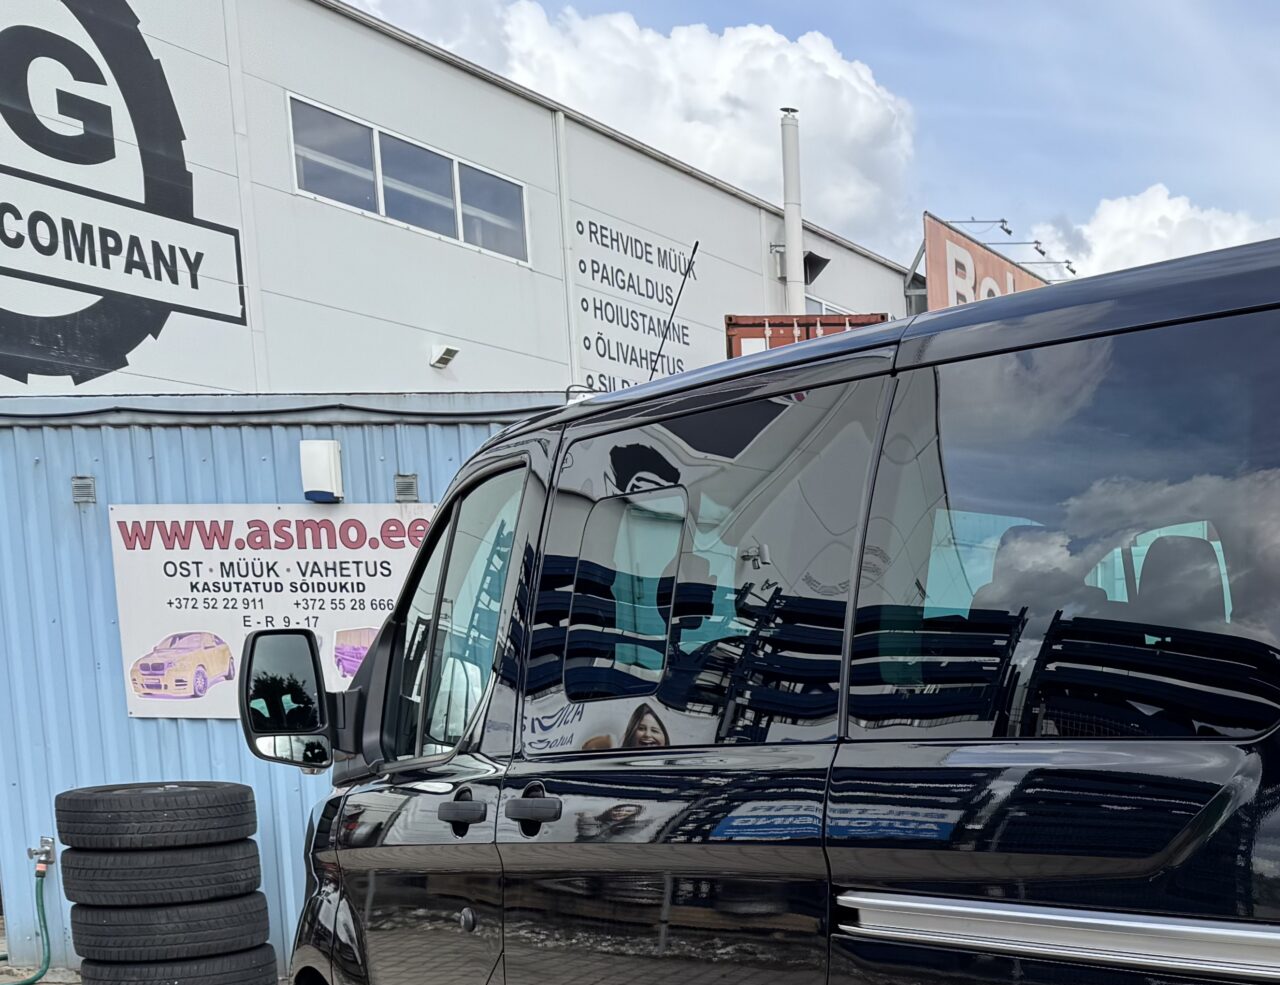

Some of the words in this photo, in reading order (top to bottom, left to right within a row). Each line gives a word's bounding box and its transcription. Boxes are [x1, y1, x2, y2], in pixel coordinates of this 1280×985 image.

[0, 202, 205, 290] COMPANY
[588, 221, 654, 265] REHVIDE
[657, 246, 697, 281] MÜÜK
[591, 259, 674, 307] PAIGALDUS
[593, 297, 691, 346] HOIUSTAMINE
[116, 518, 431, 551] www.asmo.ee
[162, 560, 204, 578] OST
[219, 557, 279, 578] MÜÜK
[296, 560, 393, 578] VAHETUS
[189, 581, 284, 593] KASUTATUD
[289, 579, 366, 593] SÕIDUKID
[166, 597, 199, 610] +372
[203, 597, 219, 610] 52
[222, 597, 239, 610] 22
[242, 597, 265, 610] 911
[293, 598, 326, 611] +372
[330, 598, 346, 611] 55
[350, 598, 366, 611] 28
[370, 598, 394, 611] 666
[243, 615, 252, 628] E
[265, 615, 275, 628] R
[304, 615, 319, 628] 17
